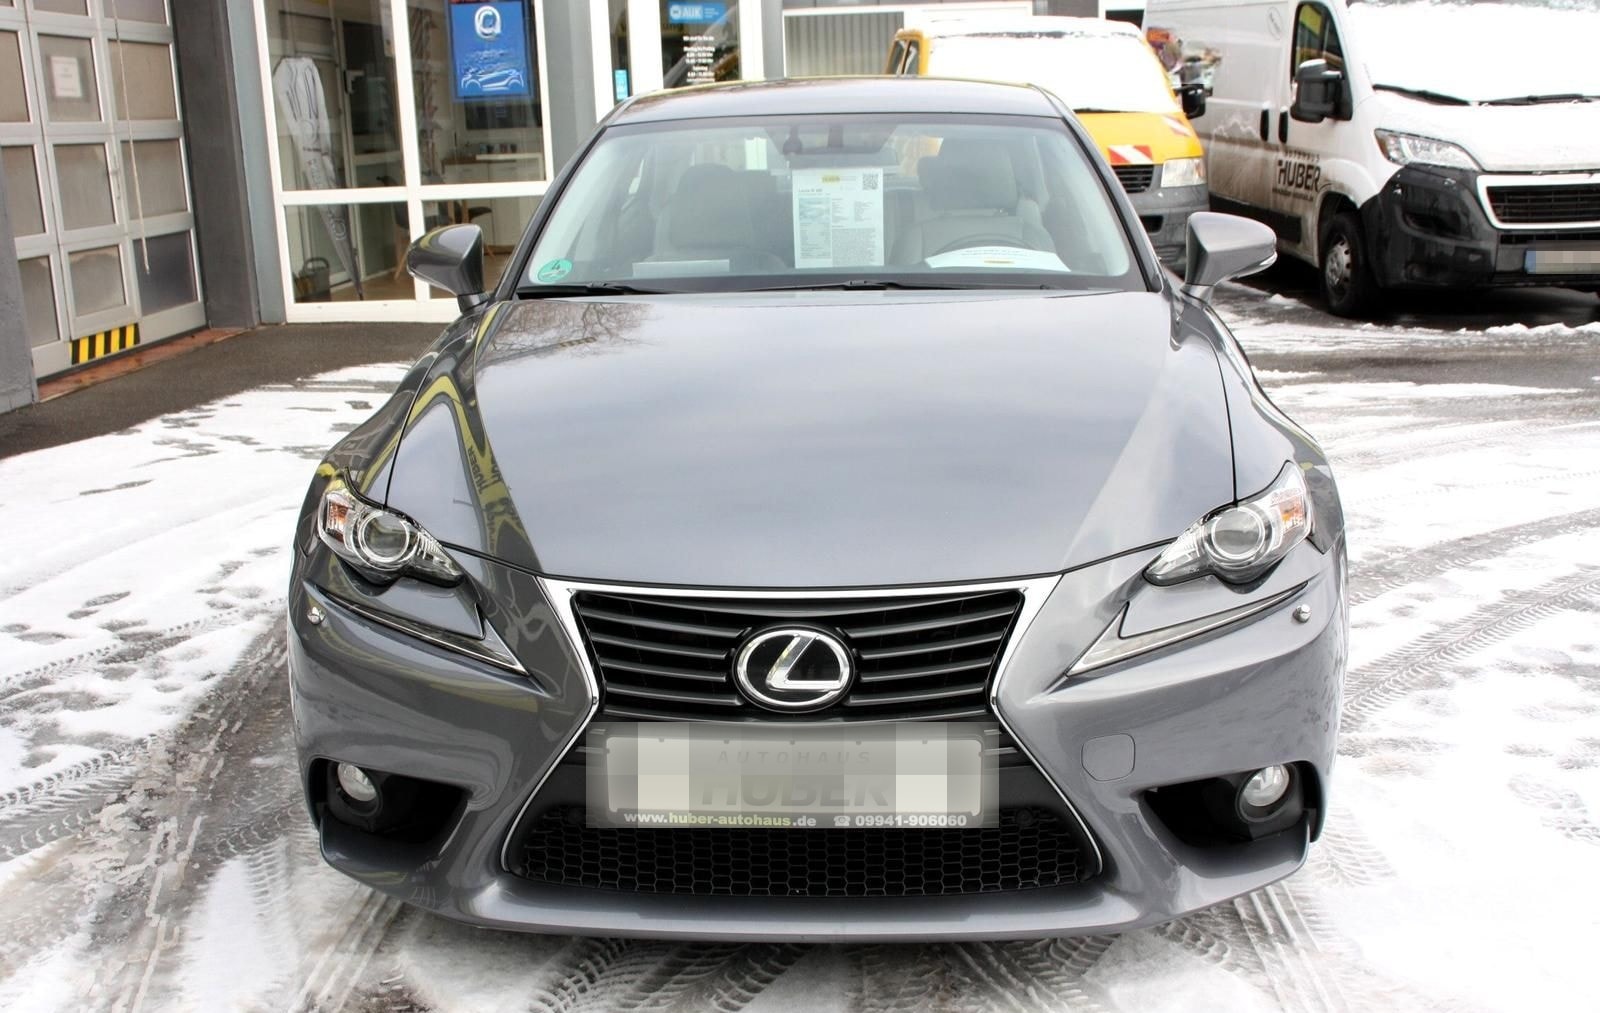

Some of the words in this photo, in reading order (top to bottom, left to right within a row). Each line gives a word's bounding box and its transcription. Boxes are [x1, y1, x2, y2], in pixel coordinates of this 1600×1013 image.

[1278, 159, 1321, 193] HUBER
[717, 751, 871, 765] AUTOHAUS
[624, 812, 817, 827] www.huber-autohaus.de
[855, 814, 967, 827] 09941-906060
